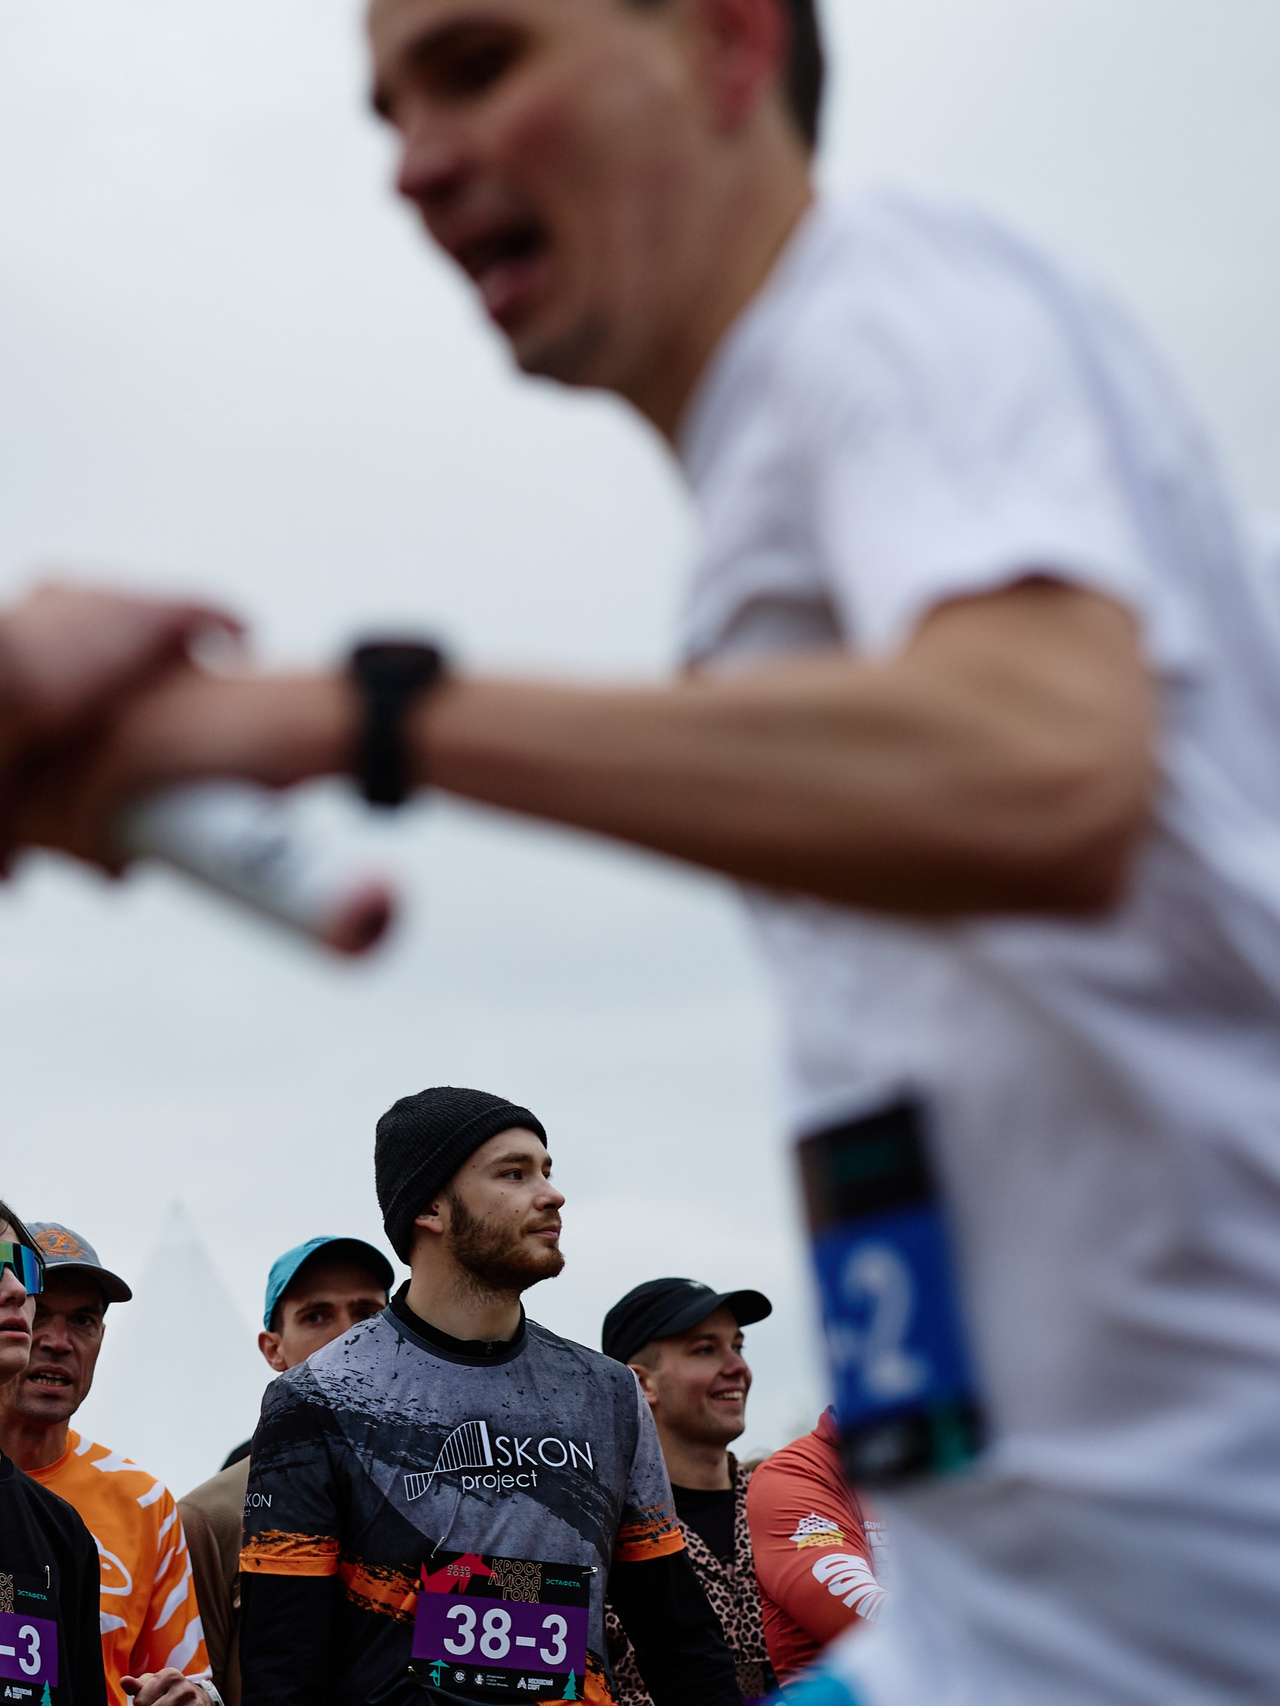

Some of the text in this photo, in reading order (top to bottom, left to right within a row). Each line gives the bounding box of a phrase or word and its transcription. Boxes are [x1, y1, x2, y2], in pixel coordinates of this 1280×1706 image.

[461, 1469, 538, 1494] project
[243, 1492, 272, 1508] KON
[447, 1570, 471, 1578] 2025
[545, 1578, 581, 1588] ЭСТАФЕТА
[502, 1586, 540, 1604] ГОРА
[443, 1604, 568, 1666] 38-3
